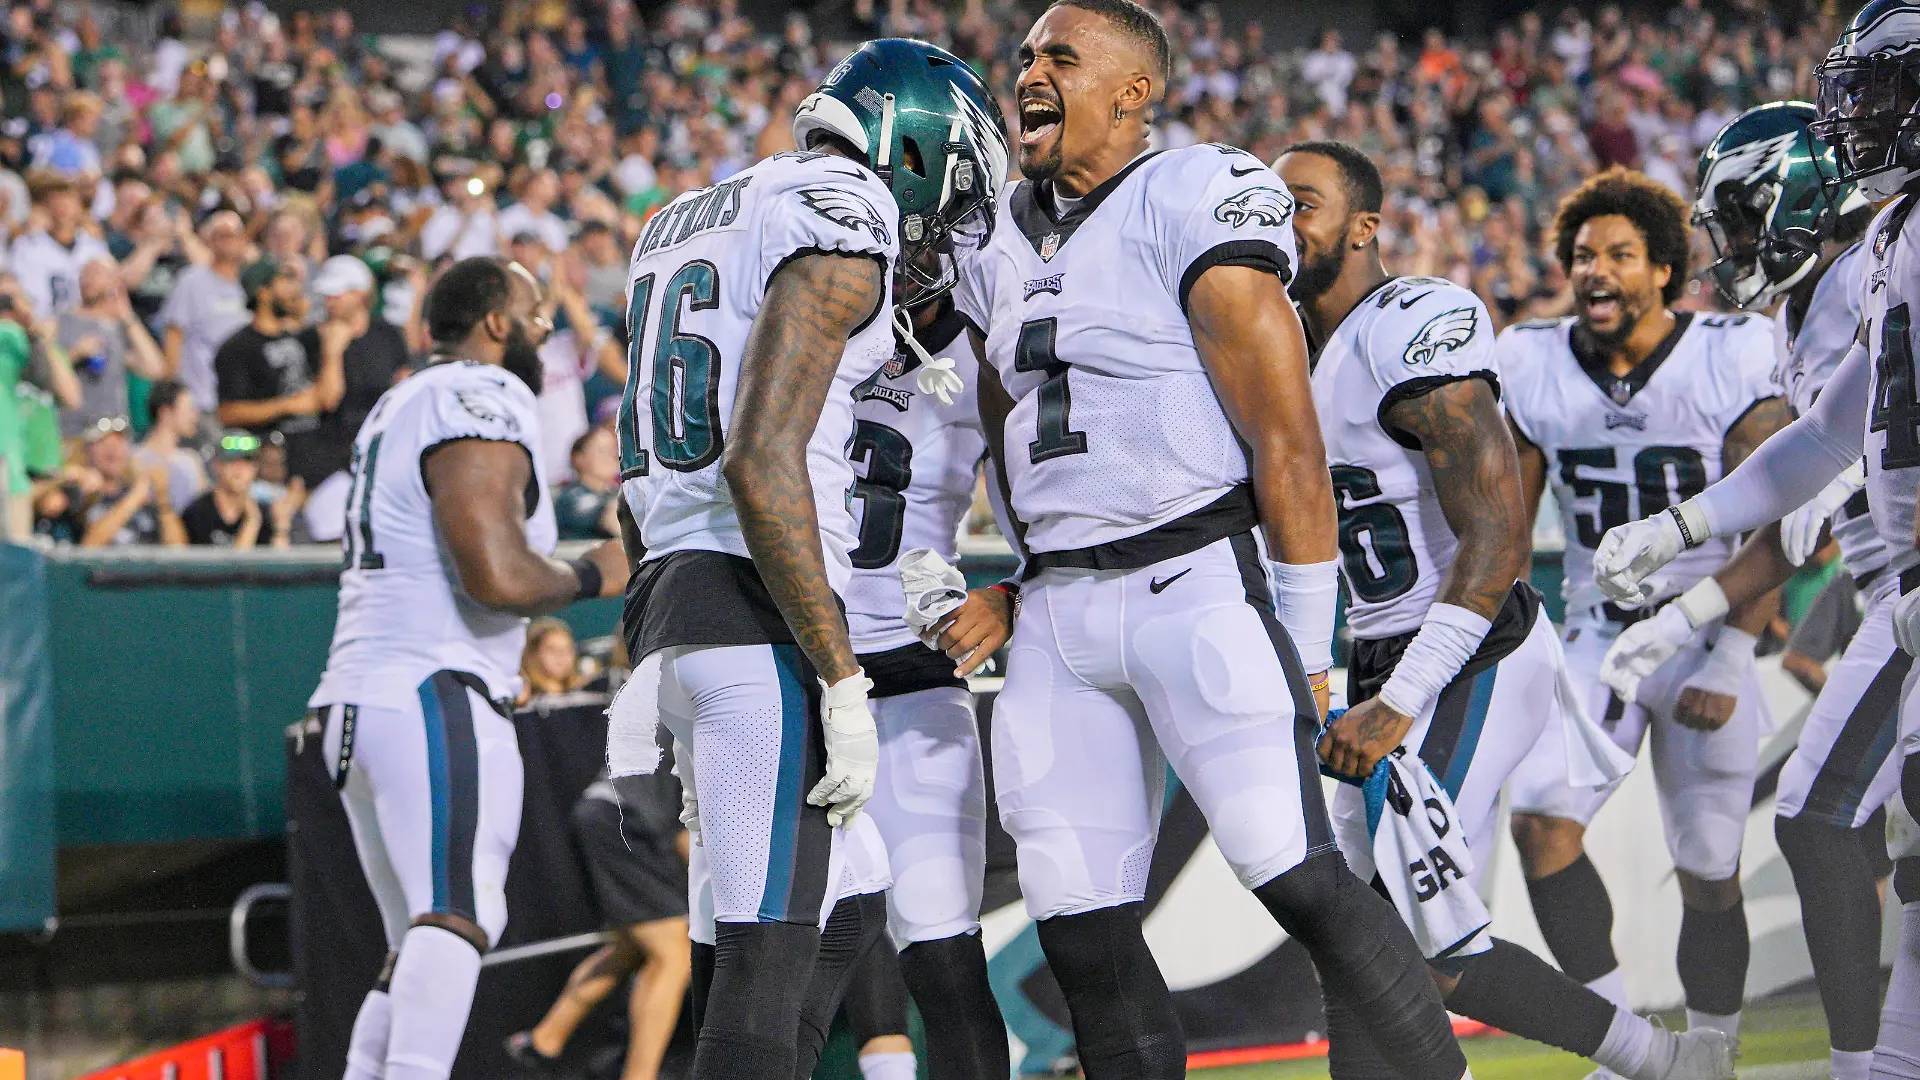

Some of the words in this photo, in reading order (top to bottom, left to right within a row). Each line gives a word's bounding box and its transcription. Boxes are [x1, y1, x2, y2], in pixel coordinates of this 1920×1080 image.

[1024, 273, 1066, 302] EAGLES
[619, 259, 724, 482] 16
[860, 385, 915, 412] AGLES
[884, 360, 902, 373] NFL
[1015, 317, 1088, 464] 1
[1556, 446, 1707, 550] 50
